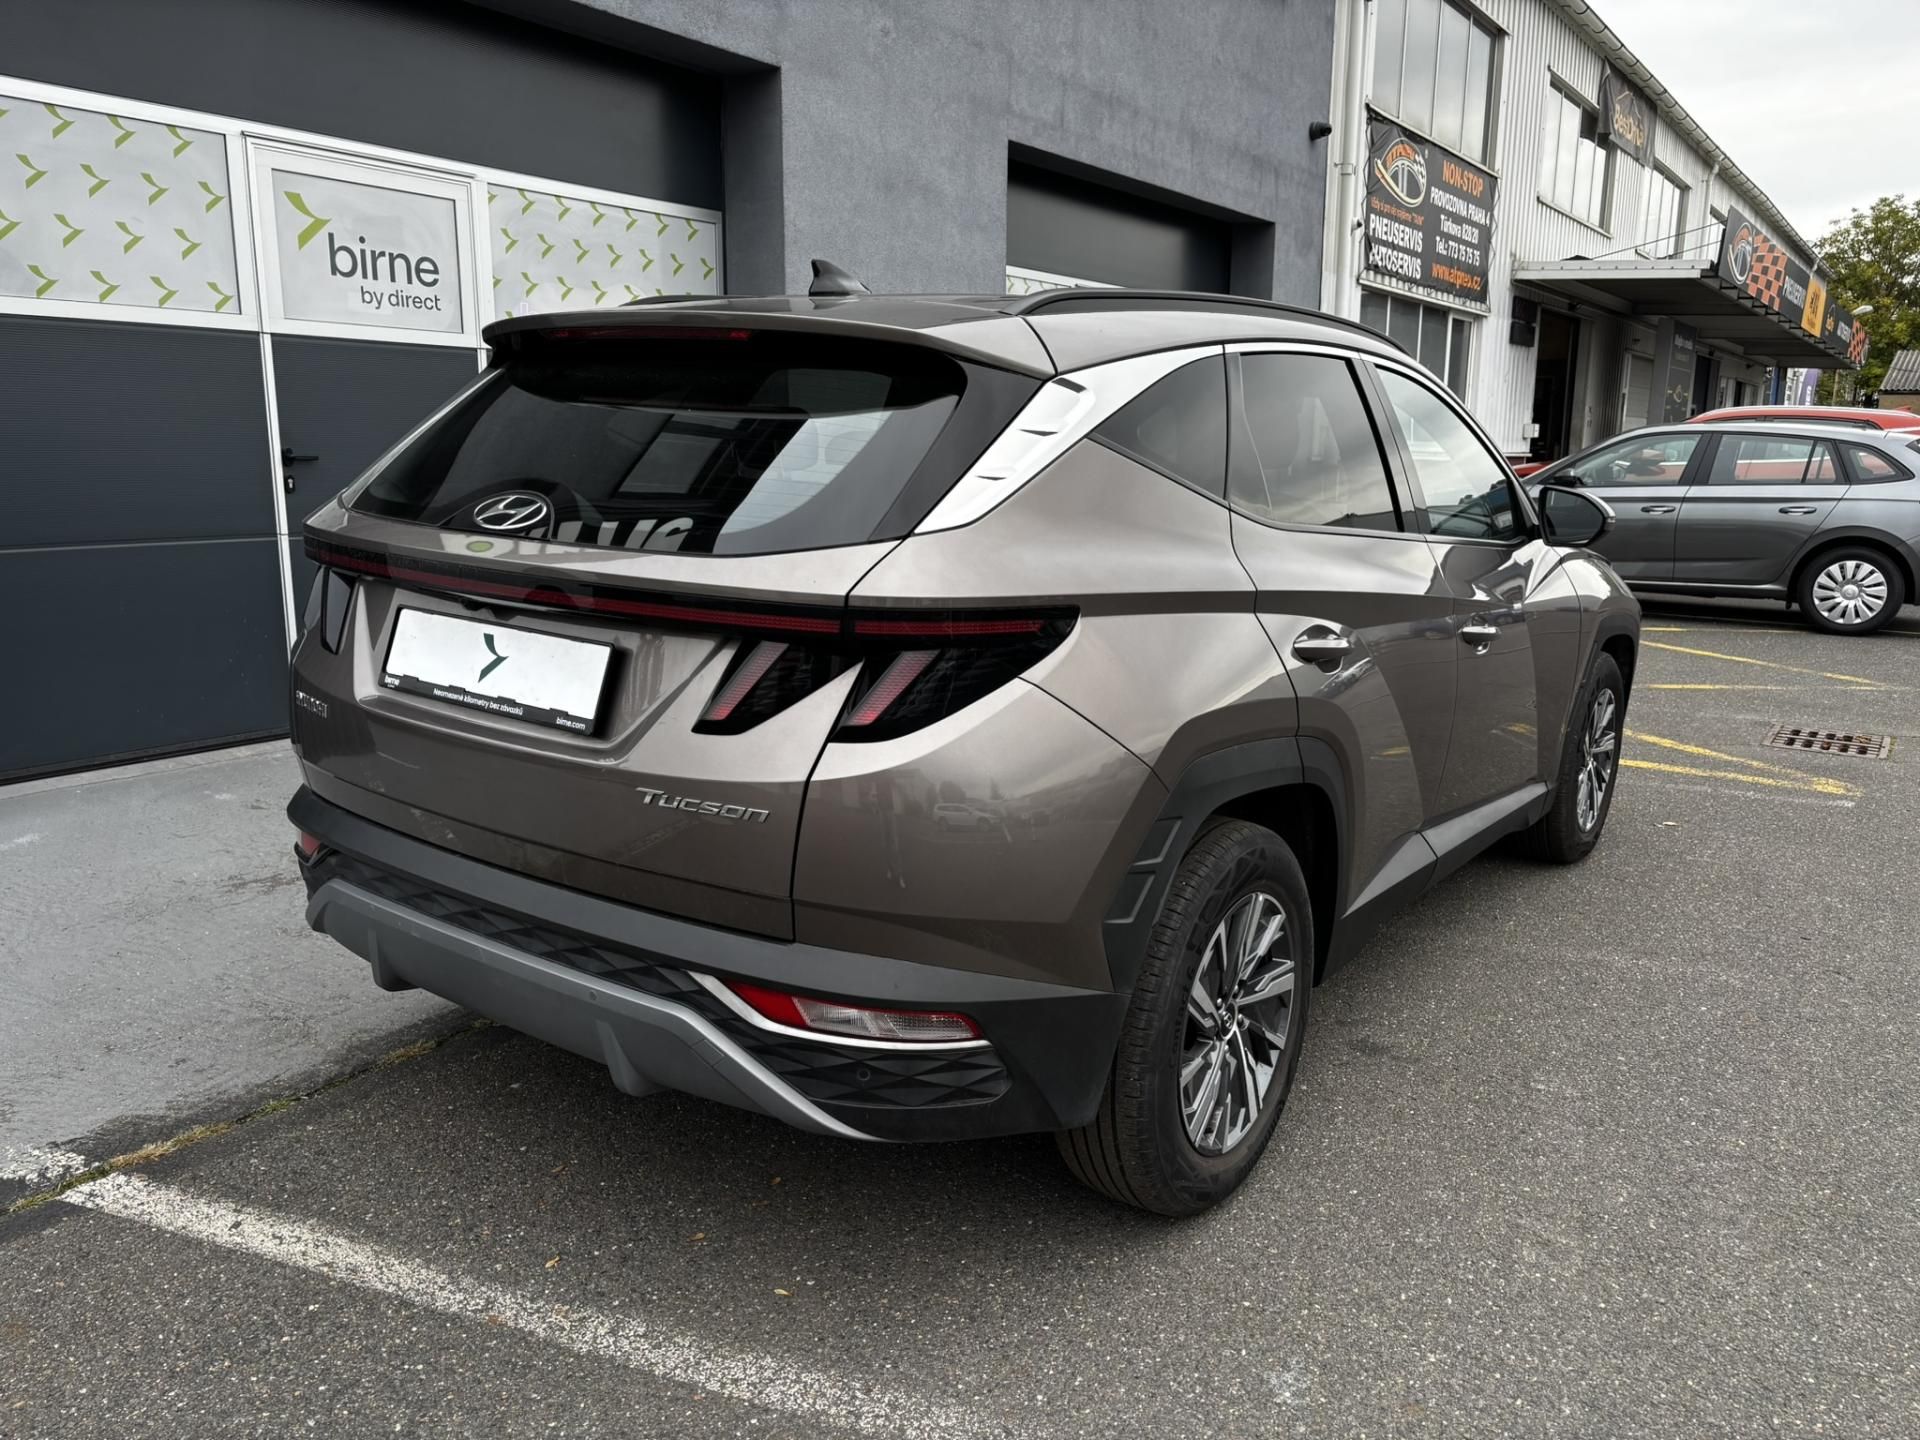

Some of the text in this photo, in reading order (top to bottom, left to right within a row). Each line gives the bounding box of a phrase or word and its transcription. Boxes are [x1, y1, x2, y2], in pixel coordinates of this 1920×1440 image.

[1443, 160, 1484, 198] NON-STOP
[1466, 201, 1486, 224] PRAHA
[1369, 213, 1423, 253] PNEUSERVIS
[327, 232, 440, 288] birne
[360, 285, 442, 311] by direct
